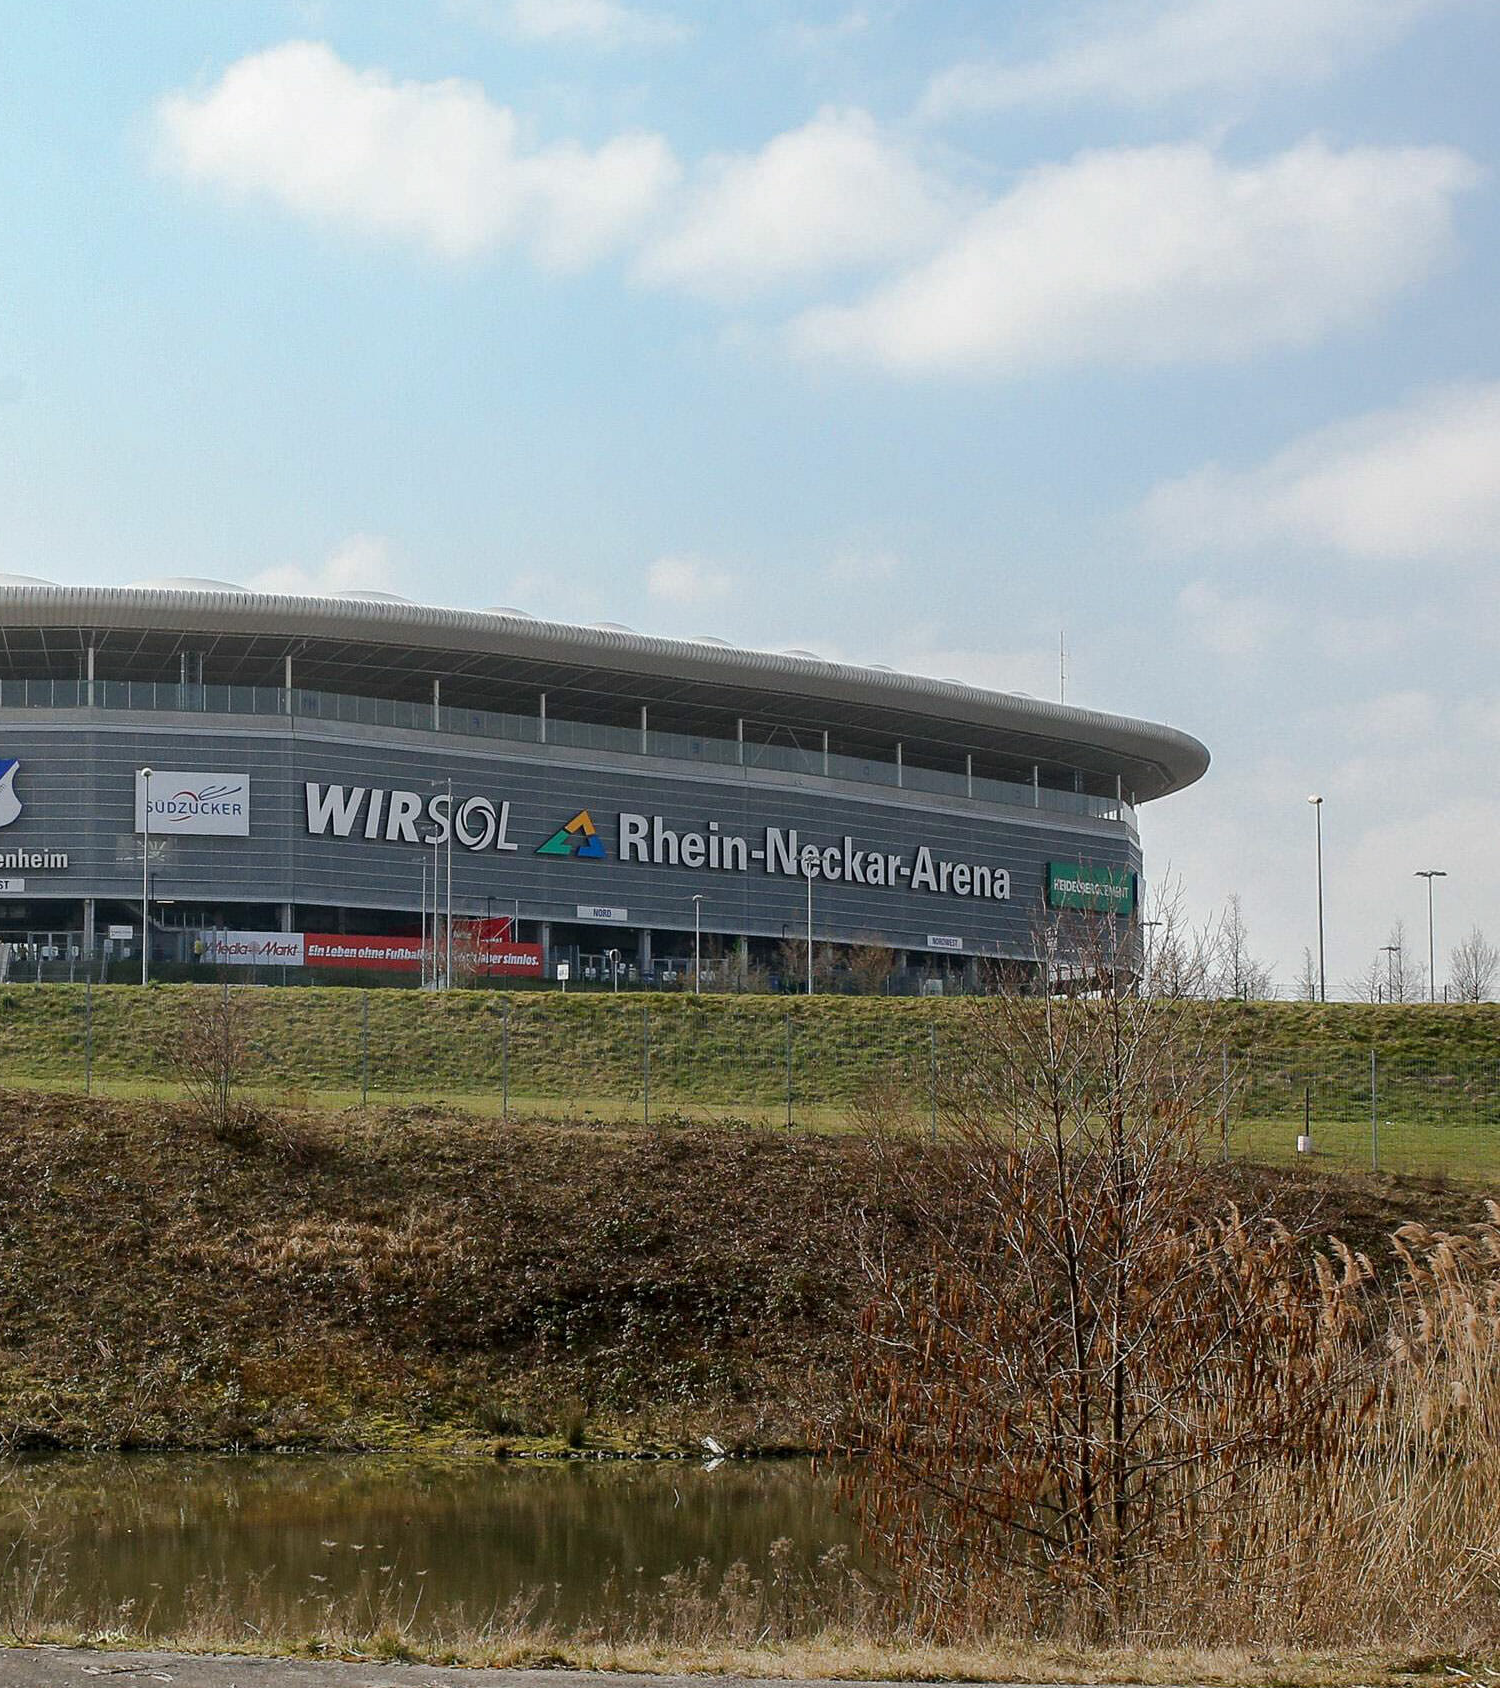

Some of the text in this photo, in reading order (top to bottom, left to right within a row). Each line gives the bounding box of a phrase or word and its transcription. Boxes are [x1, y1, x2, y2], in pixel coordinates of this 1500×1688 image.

[305, 782, 519, 851] WIRSOL
[618, 812, 1012, 901] Rhein-Neckar-Arena
[593, 908, 612, 918] NORD
[258, 941, 299, 956] Markt
[308, 945, 324, 956] Ein
[325, 945, 357, 957] Leben
[358, 946, 385, 958] ohne
